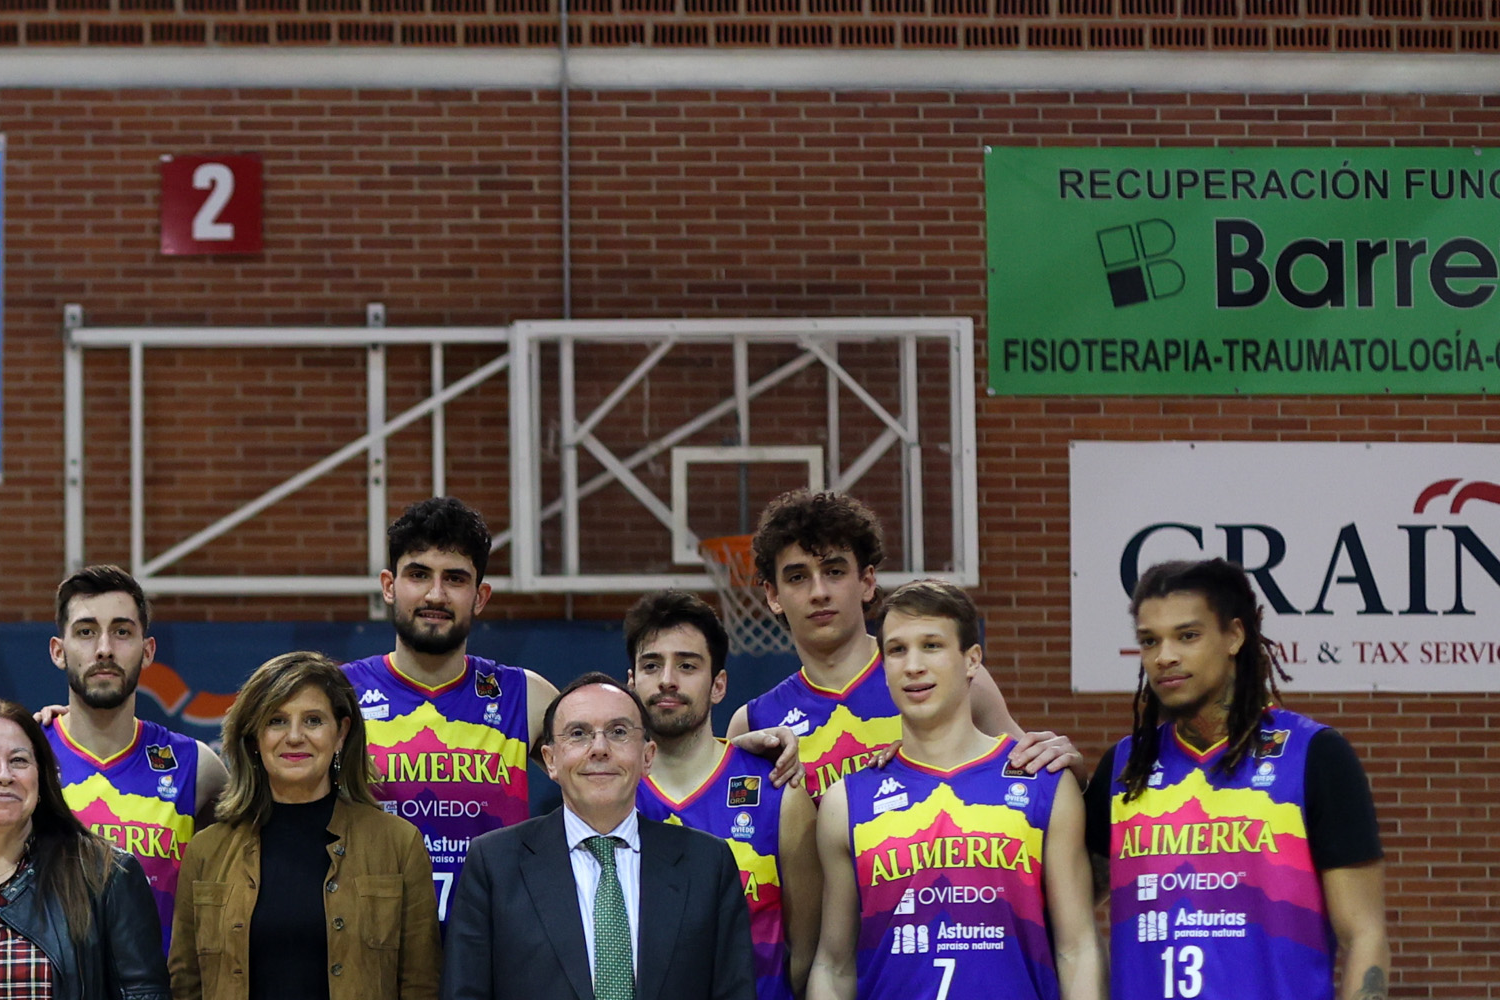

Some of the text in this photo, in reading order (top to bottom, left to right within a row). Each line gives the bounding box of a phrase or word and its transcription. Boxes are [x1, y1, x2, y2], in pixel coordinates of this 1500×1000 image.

[1059, 160, 1389, 200] RECUPERACIÓN
[192, 162, 235, 240] 2
[1214, 217, 1499, 310] Barre
[1317, 641, 1342, 664] &
[1352, 641, 1410, 664] TAX
[366, 752, 511, 785] LIMERKA
[1118, 821, 1279, 860] ALIMERKA
[870, 835, 1034, 887] ALIMERKA
[936, 921, 1005, 939] Asturias
[1174, 907, 1246, 927] Asturias
[1211, 928, 1246, 938] natural
[971, 940, 1005, 951] natural
[1160, 945, 1204, 999] 13
